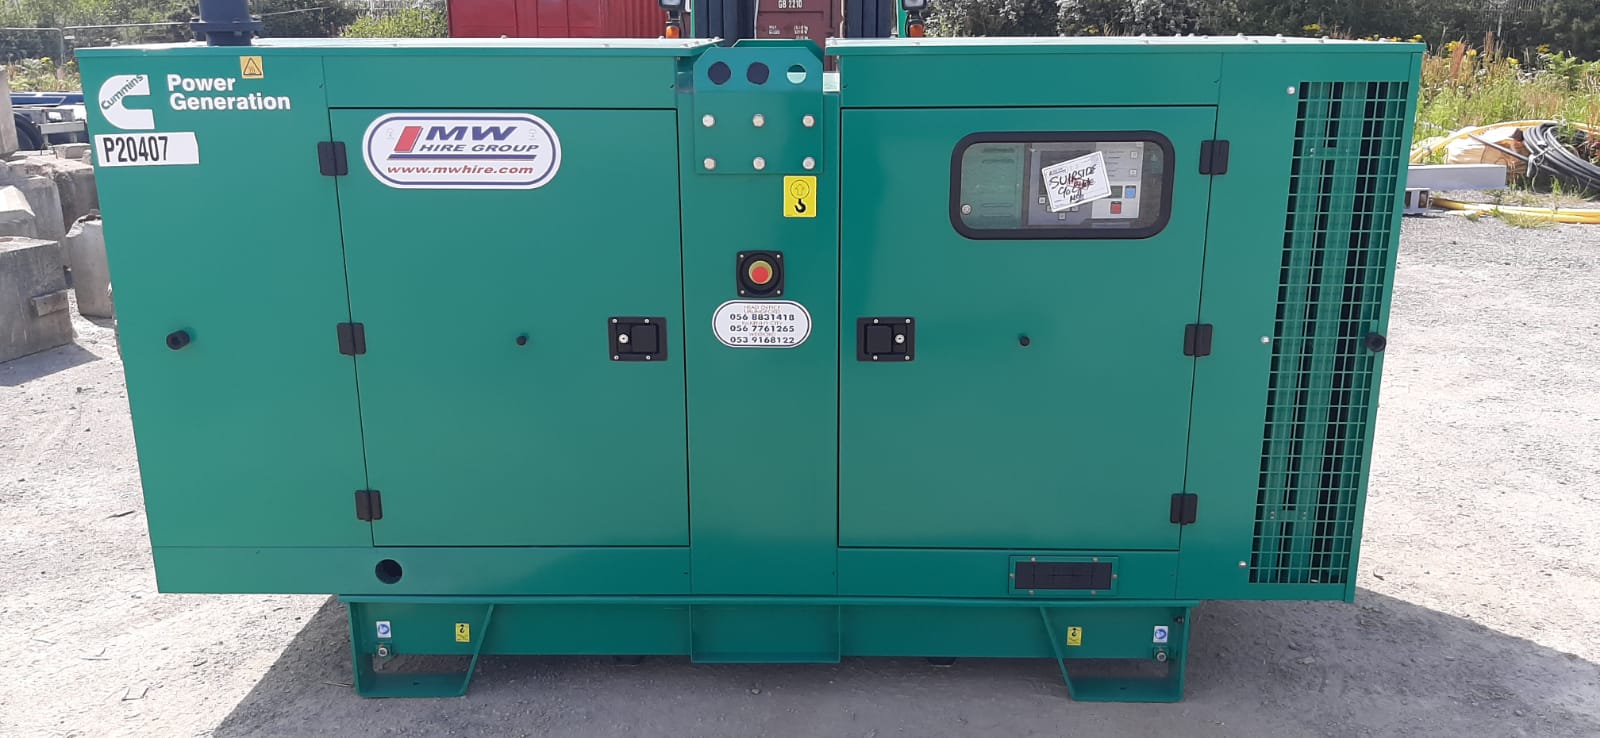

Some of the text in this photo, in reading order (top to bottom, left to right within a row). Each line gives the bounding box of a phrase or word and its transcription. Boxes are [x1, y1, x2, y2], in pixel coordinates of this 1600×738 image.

[167, 73, 236, 91] Power
[101, 73, 144, 111] Cummins
[169, 92, 291, 111] Generation
[425, 126, 518, 141] MW
[103, 136, 168, 163] P20407
[419, 144, 540, 152] HIRE GROUP
[387, 165, 534, 174] www.mwhire.com
